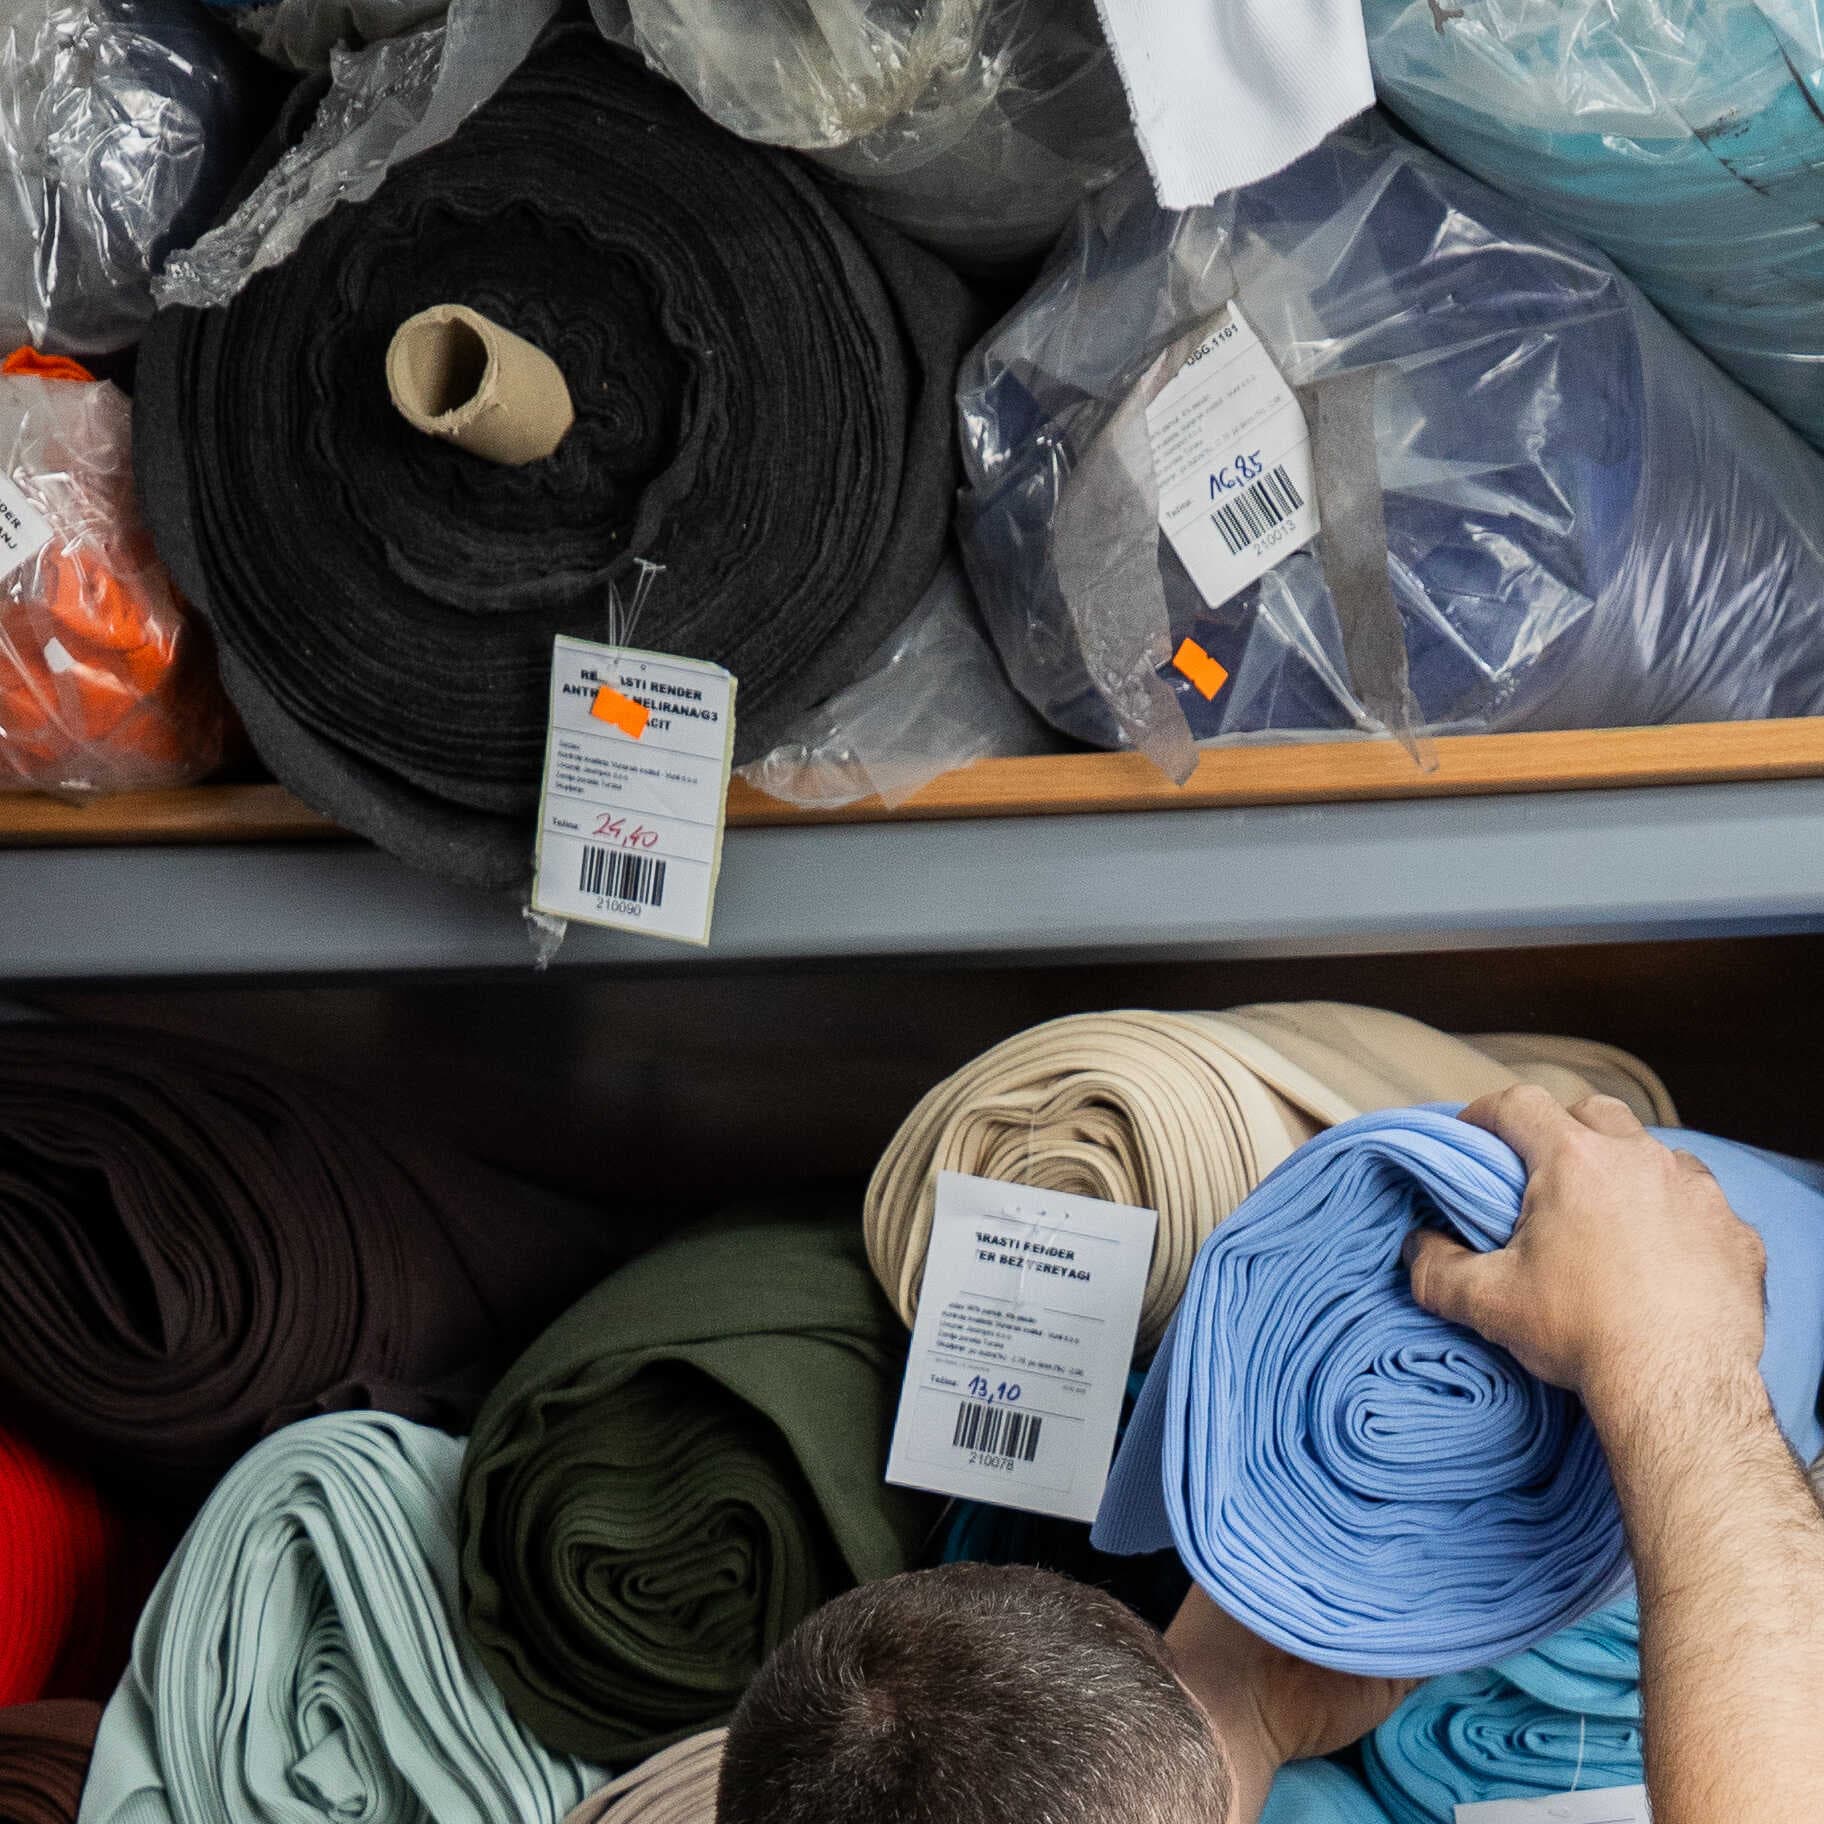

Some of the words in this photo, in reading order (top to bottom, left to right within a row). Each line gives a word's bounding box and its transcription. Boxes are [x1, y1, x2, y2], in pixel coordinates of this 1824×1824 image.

[1253, 519, 1297, 556] 210013
[650, 681, 703, 701] RENDER
[596, 896, 642, 917] 210090
